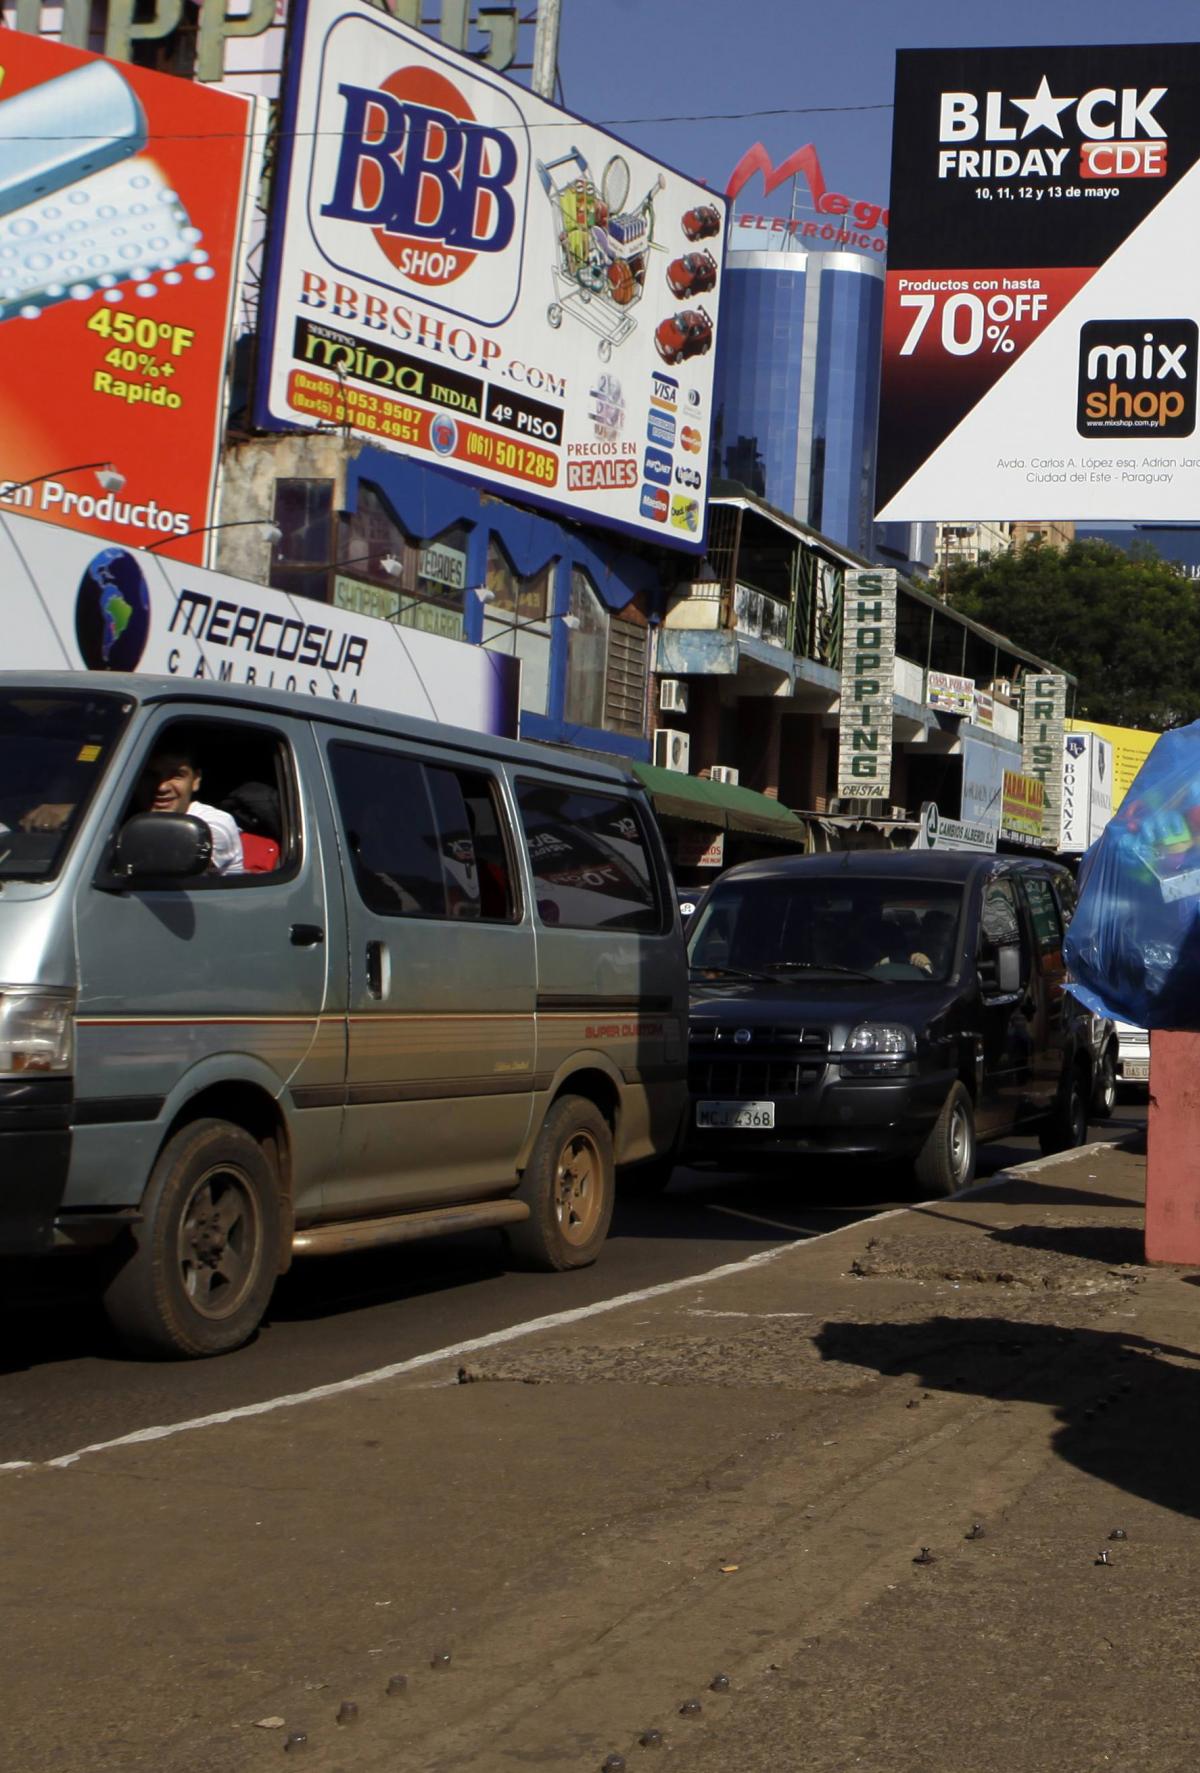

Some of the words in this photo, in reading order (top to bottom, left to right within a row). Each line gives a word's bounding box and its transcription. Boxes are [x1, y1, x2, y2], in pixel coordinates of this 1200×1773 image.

[320, 82, 518, 253] BBB
[938, 149, 1070, 178] FRIDAY
[1087, 145, 1161, 175] CDE
[975, 188, 993, 200] 10,
[998, 188, 1014, 200] 11,
[1019, 187, 1033, 198] 12
[1036, 190, 1043, 200] y
[1048, 187, 1062, 198] 13
[1066, 187, 1081, 198] de
[1085, 189, 1120, 199] mayo
[399, 248, 457, 279] SHOP
[898, 280, 969, 291] Productos
[973, 281, 999, 289] con
[1003, 278, 1040, 289] hasta
[899, 293, 985, 356] 70
[987, 293, 1048, 321] OFF
[105, 347, 175, 378] 40%+
[1087, 333, 1187, 379] mix
[93, 371, 182, 409] Rapido
[430, 383, 478, 414] INDIA
[654, 381, 677, 404] VISA
[1086, 383, 1184, 426] shop
[517, 411, 557, 439] PISO
[495, 440, 555, 481] 501285
[567, 442, 617, 456] PRECIOS
[622, 442, 637, 454] EN
[997, 457, 1027, 469] Avda.
[1031, 457, 1065, 468] Carlos
[1067, 457, 1077, 468] A.
[1116, 459, 1138, 472] esq.
[567, 459, 637, 490] REALES
[1026, 472, 1067, 483] Ciudad
[1070, 472, 1087, 483] del
[1090, 473, 1112, 483] Este
[1122, 472, 1173, 487] Paraguay
[41, 480, 191, 535] Productos
[169, 589, 368, 677] MERCOSUR
[851, 574, 882, 777] SHOPPING
[1033, 679, 1055, 832] CRIST
[842, 785, 884, 797] CRISTAL
[1063, 763, 1076, 841] BONANZA
[585, 1025, 620, 1038] SUPER
[735, 1111, 770, 1126] 4368
